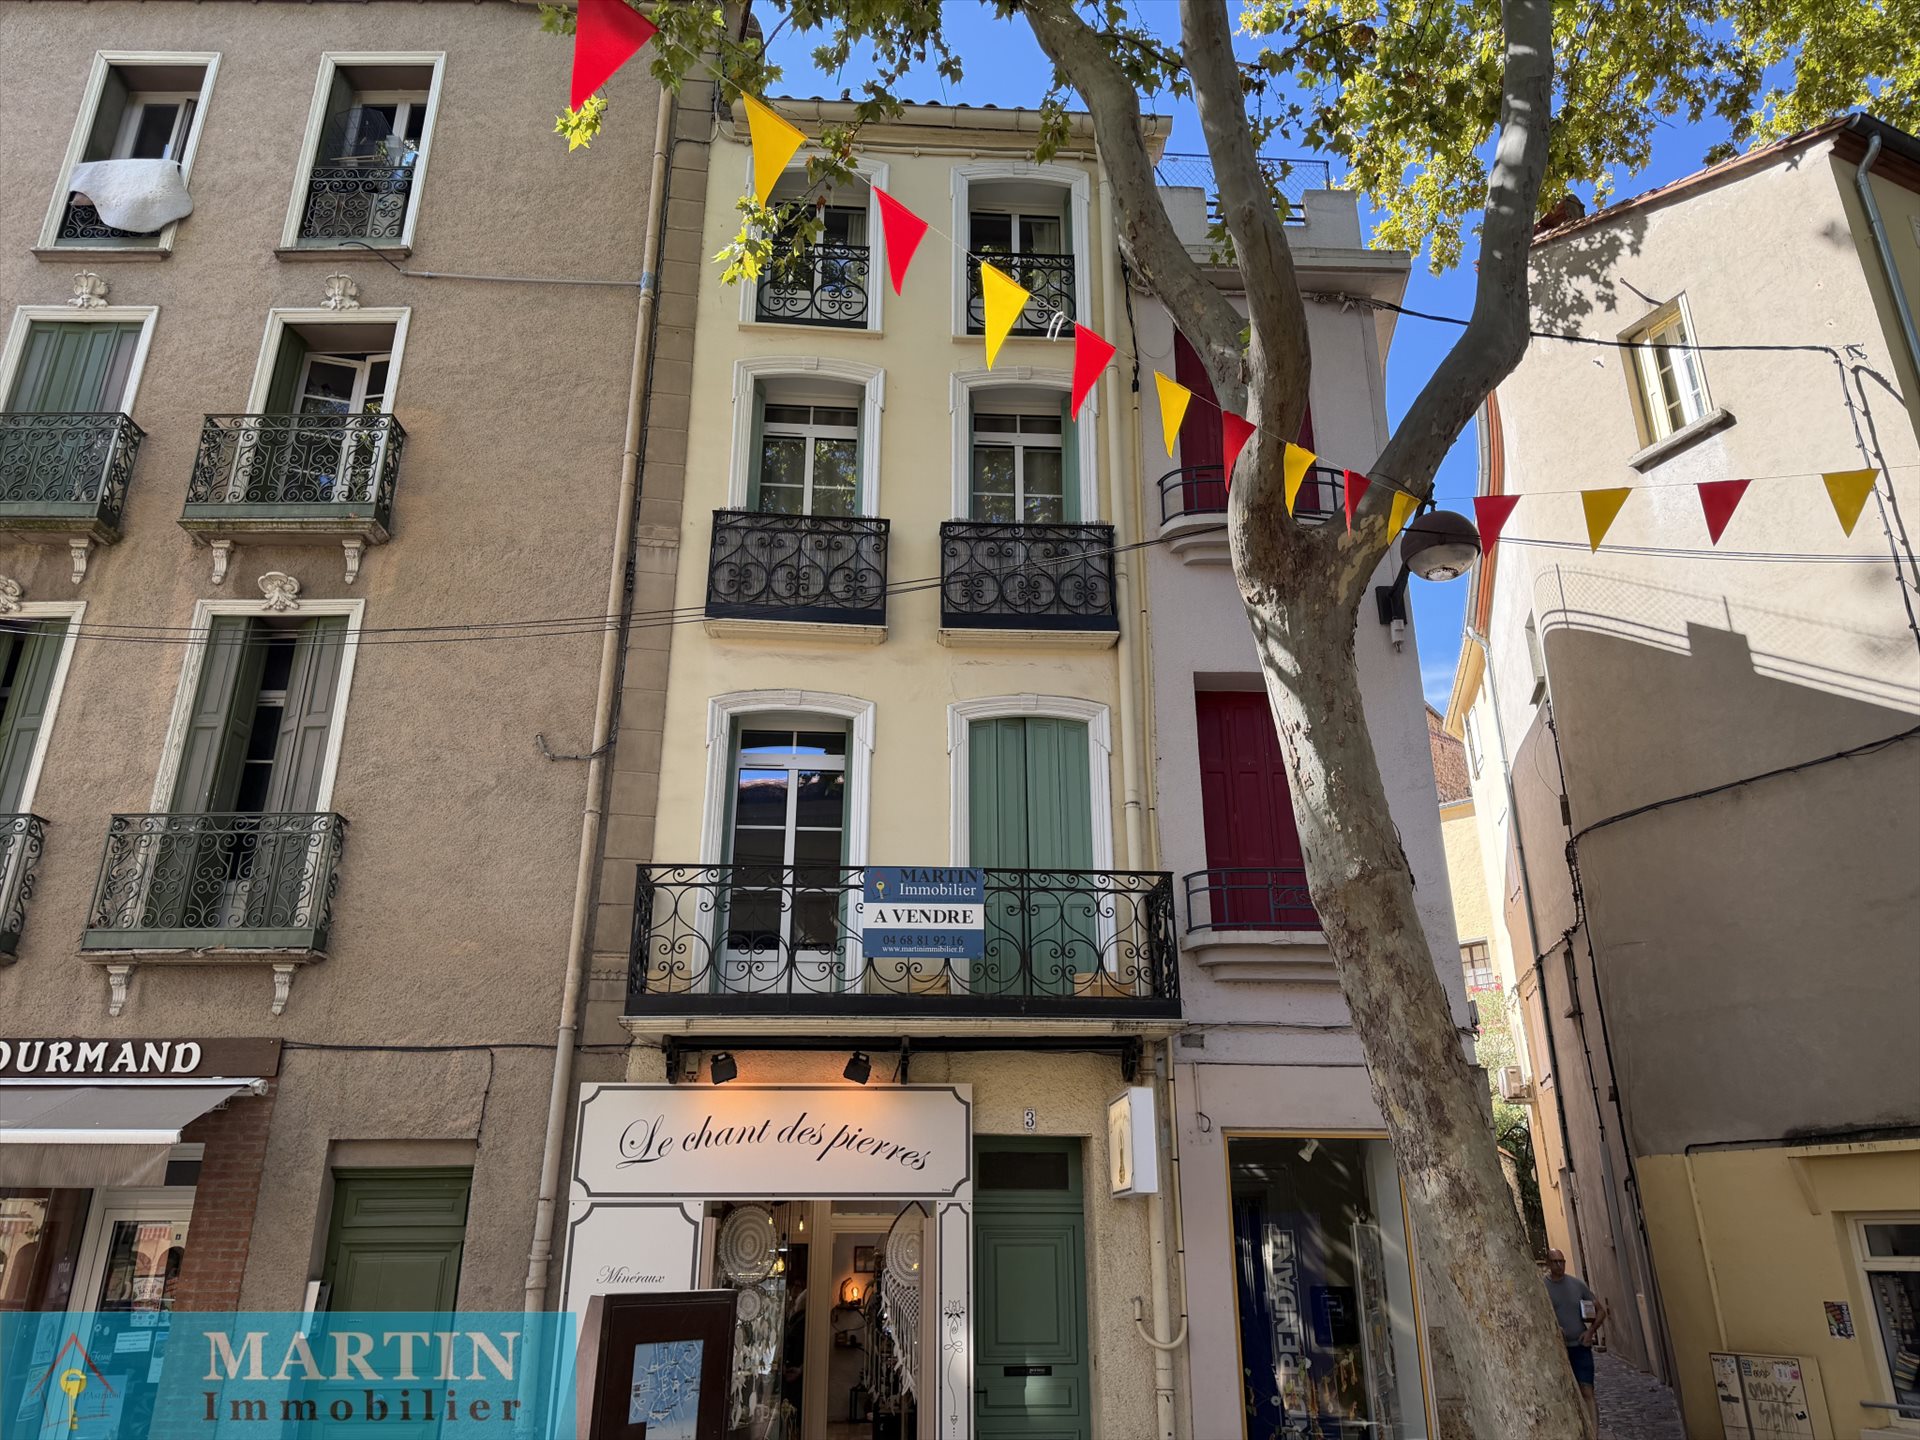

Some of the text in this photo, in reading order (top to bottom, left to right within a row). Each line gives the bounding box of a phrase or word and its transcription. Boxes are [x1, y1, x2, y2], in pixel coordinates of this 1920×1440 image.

[900, 868, 978, 883] MARTIN
[900, 883, 977, 896] Immobilier
[874, 909, 974, 924] A VENDRE
[883, 935, 964, 946] 04 68 81 92 16
[1025, 1111, 1035, 1127] 3
[615, 1112, 932, 1171] Le chant des pierres
[596, 1265, 665, 1284] Minéraux
